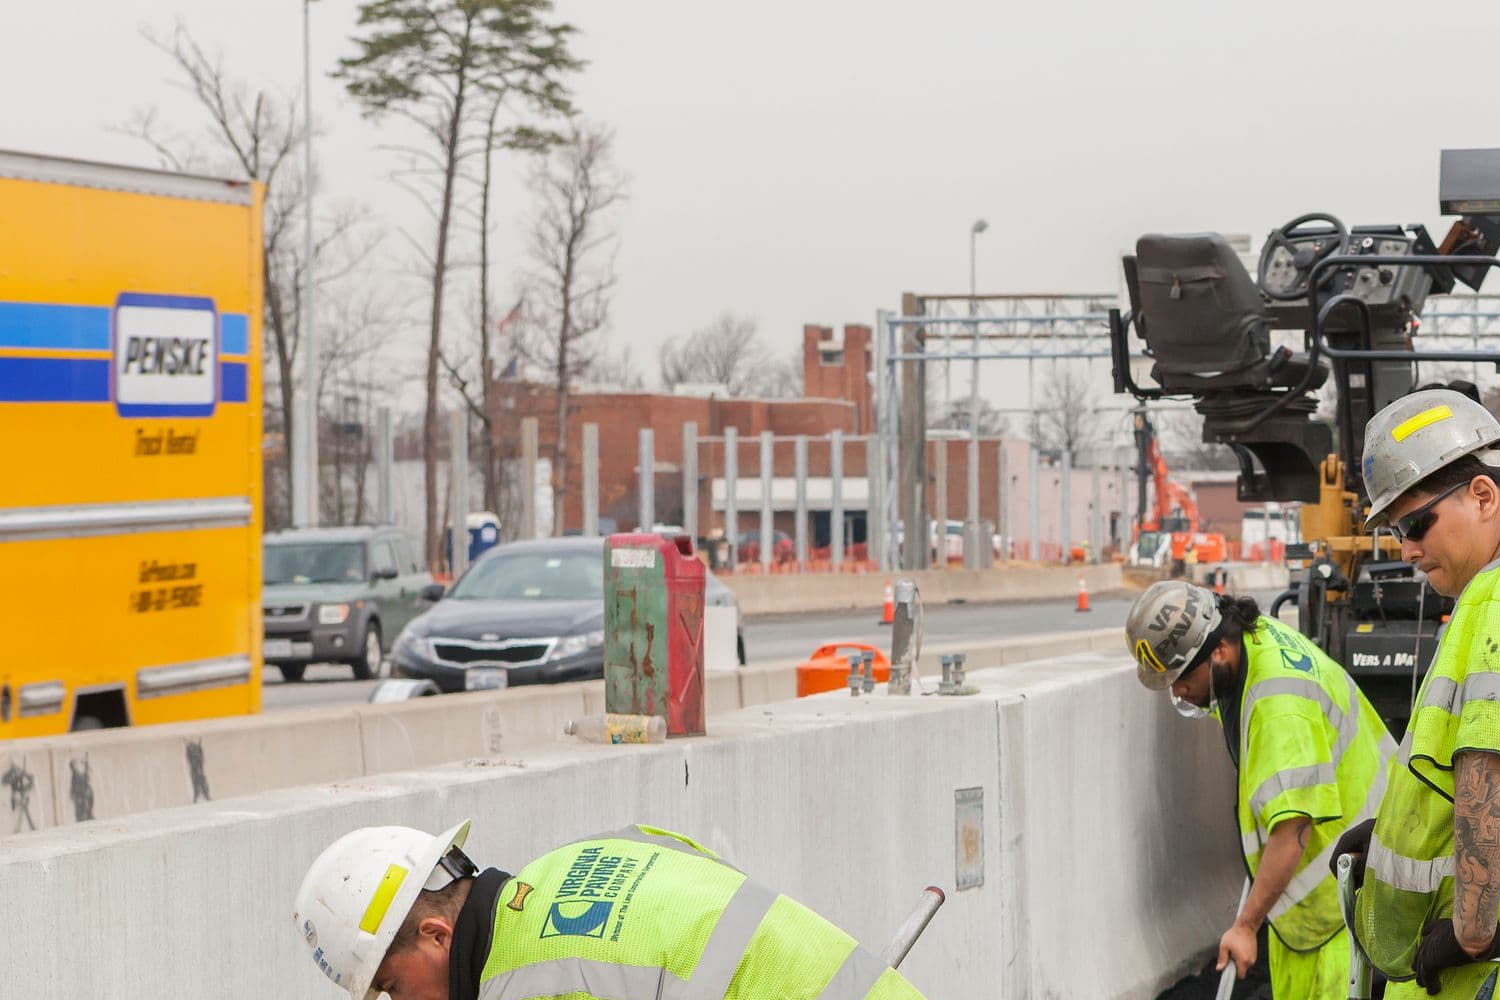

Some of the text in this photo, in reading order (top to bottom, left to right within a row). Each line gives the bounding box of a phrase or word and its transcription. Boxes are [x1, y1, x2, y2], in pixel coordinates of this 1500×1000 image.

[124, 336, 209, 376] PENSKE
[1148, 604, 1180, 631] VA
[555, 846, 604, 898] VIRGINIA
[579, 856, 622, 897] PAVING
[604, 857, 639, 897] COMPANY
